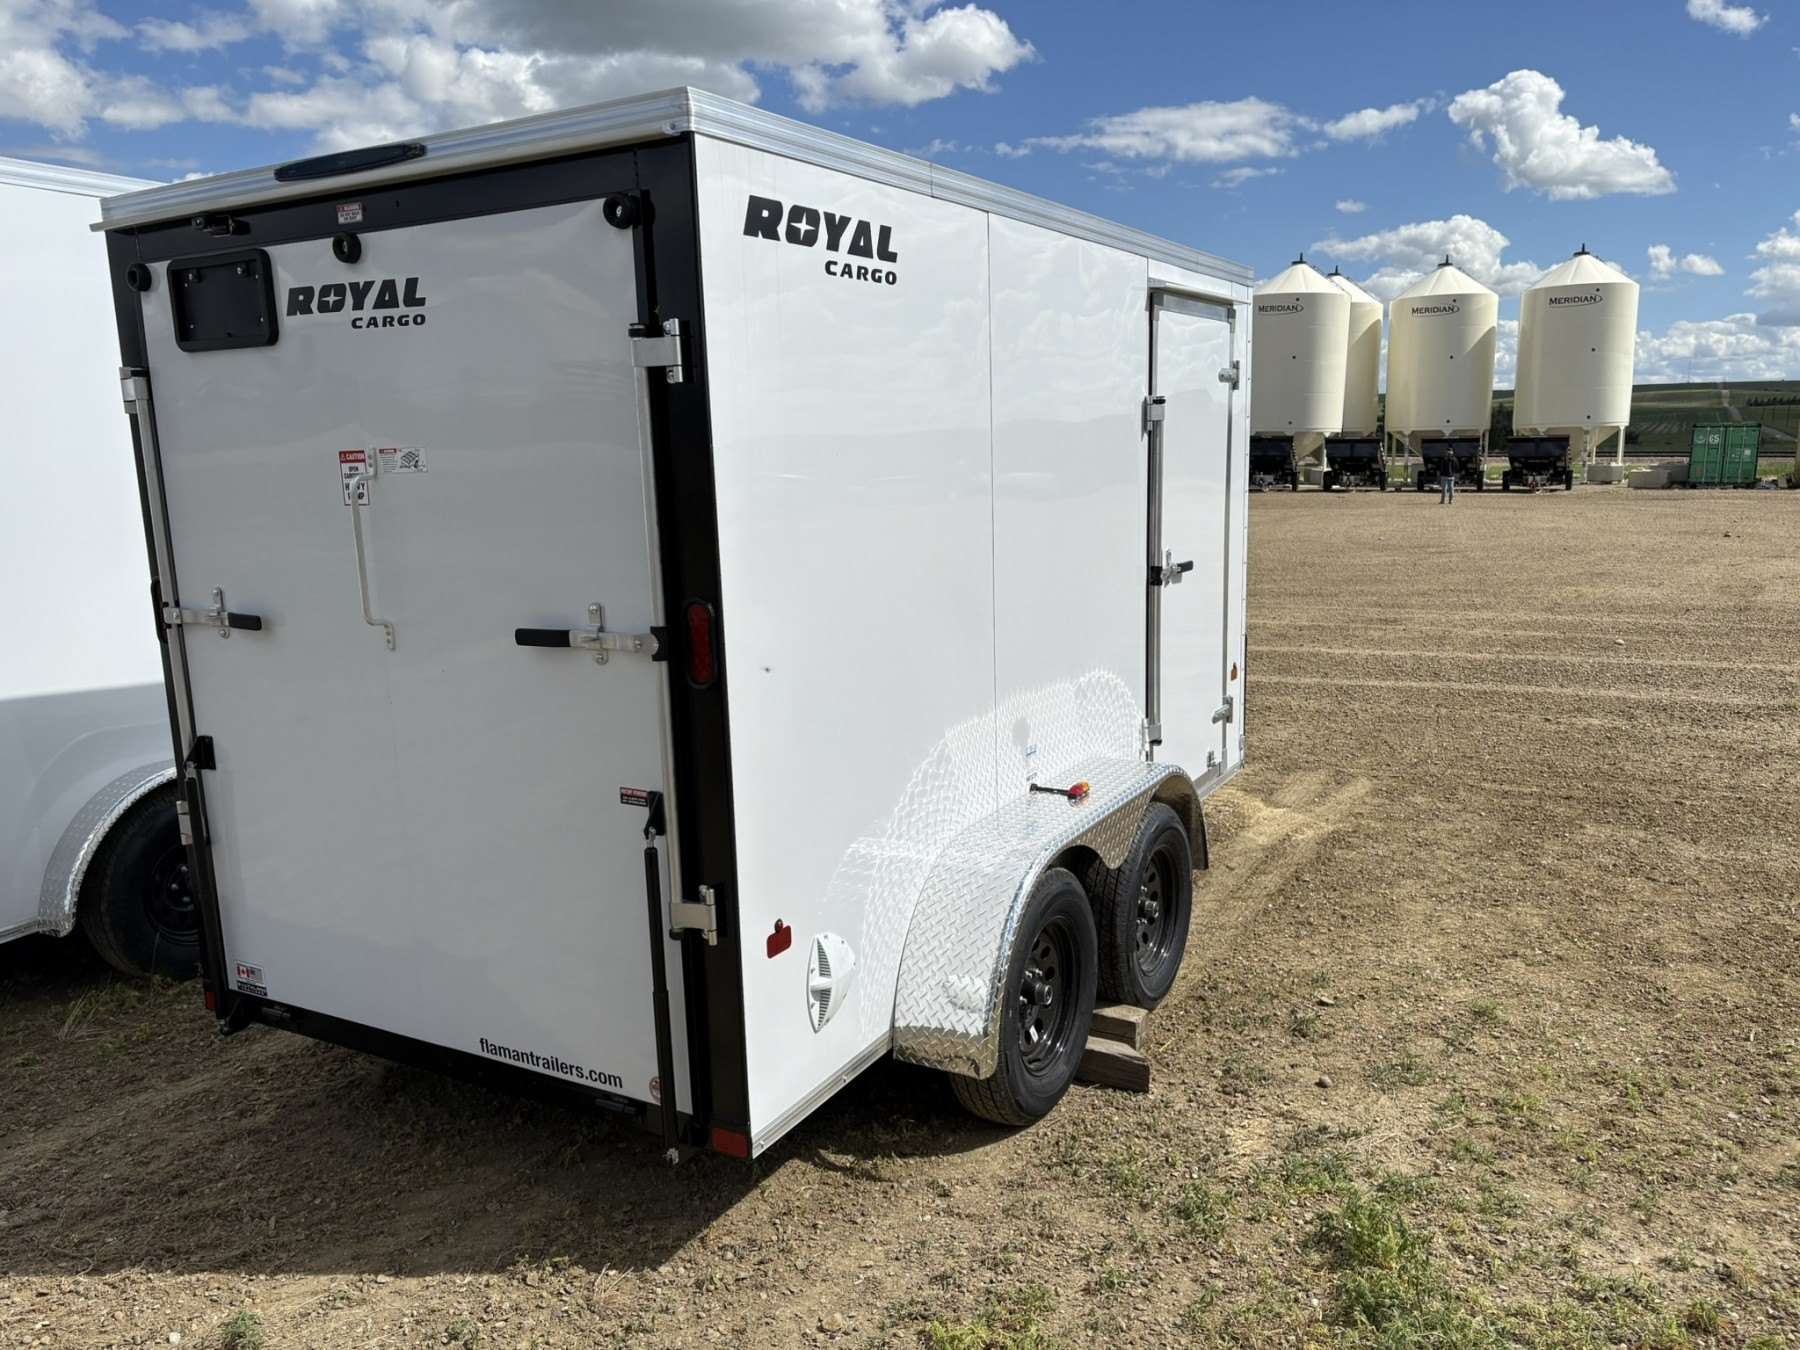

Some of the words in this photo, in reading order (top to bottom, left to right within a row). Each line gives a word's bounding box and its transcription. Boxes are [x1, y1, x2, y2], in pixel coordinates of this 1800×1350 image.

[743, 194, 898, 263] ROYAL
[825, 260, 897, 285] CARGO
[286, 277, 427, 317] ROYAL
[1549, 295, 1597, 305] MERIDIAN
[1258, 304, 1299, 313] MERIDIAN
[1411, 306, 1455, 315] MERIDIAN
[351, 313, 426, 329] CARGO
[479, 1037, 623, 1089] flamantrailers.com
